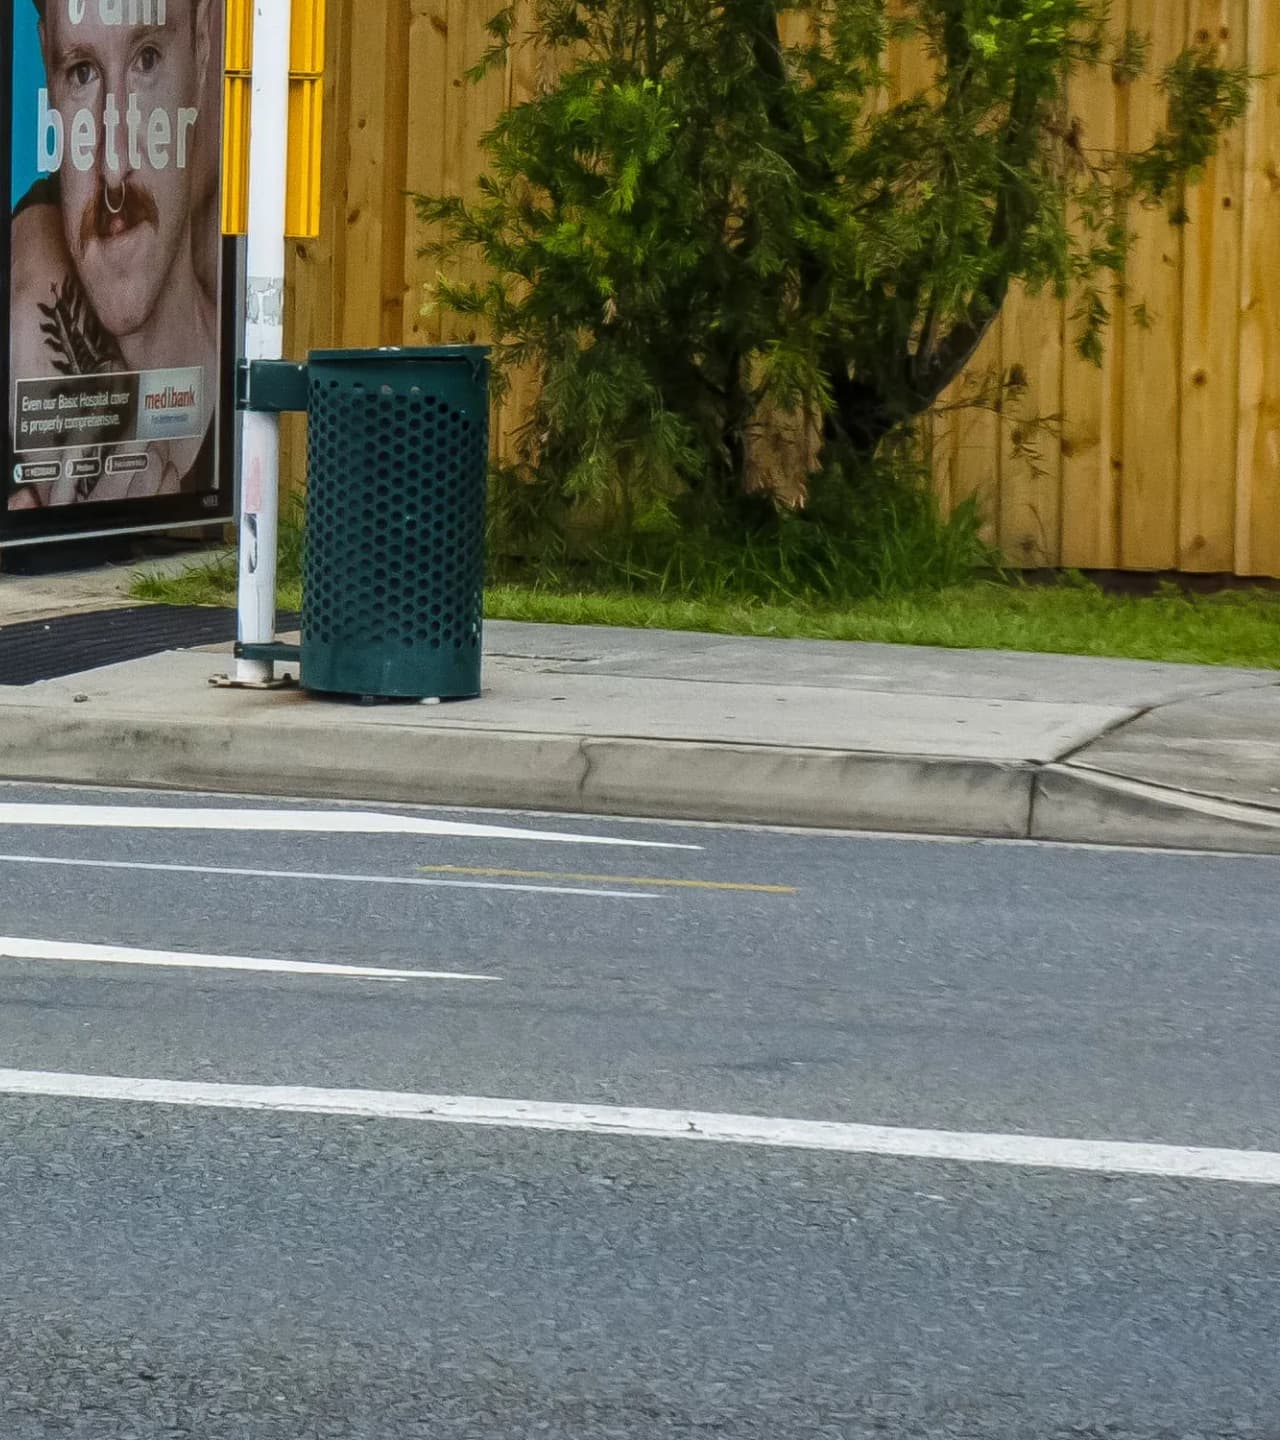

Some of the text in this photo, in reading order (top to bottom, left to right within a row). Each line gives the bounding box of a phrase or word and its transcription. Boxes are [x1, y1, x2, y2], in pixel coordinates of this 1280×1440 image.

[36, 87, 198, 174] better
[22, 391, 130, 412] Even our Basic Hospital cover
[144, 384, 196, 411] medibank
[21, 416, 28, 433] is
[29, 414, 64, 435] properly
